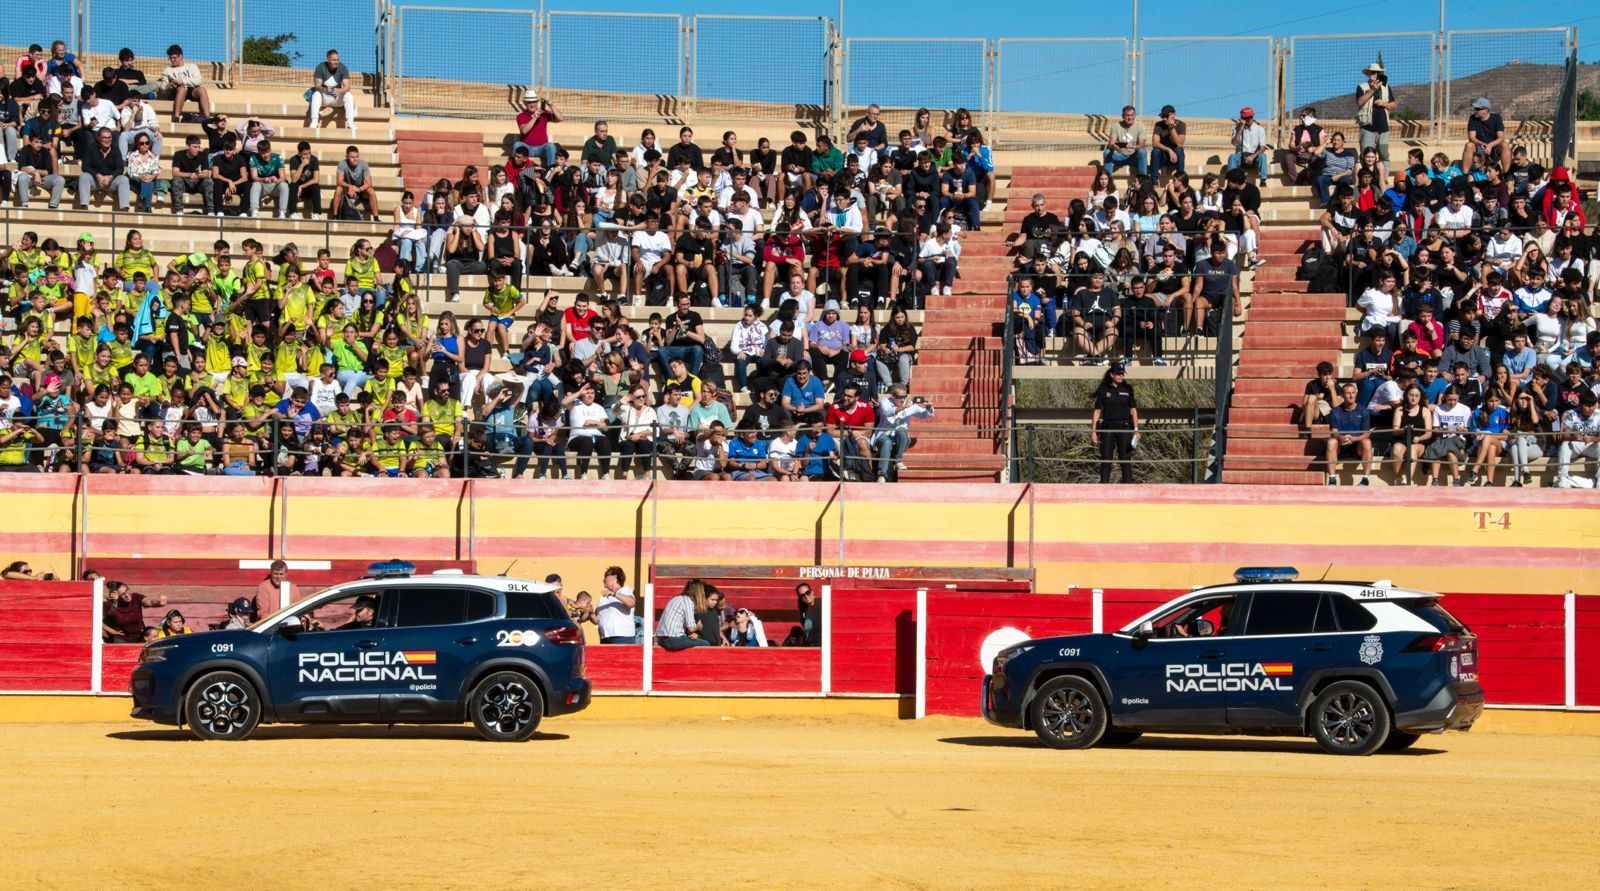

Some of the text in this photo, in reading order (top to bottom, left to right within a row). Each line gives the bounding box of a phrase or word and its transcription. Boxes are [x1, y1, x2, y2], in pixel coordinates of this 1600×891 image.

[1473, 511, 1512, 530] T-4
[799, 566, 890, 578] PERSONAL DE PLAZA
[507, 583, 529, 592] 9LK
[1360, 589, 1384, 598] 4HB
[298, 666, 437, 683] NACIONAL
[1166, 678, 1293, 692] NACIONAL
